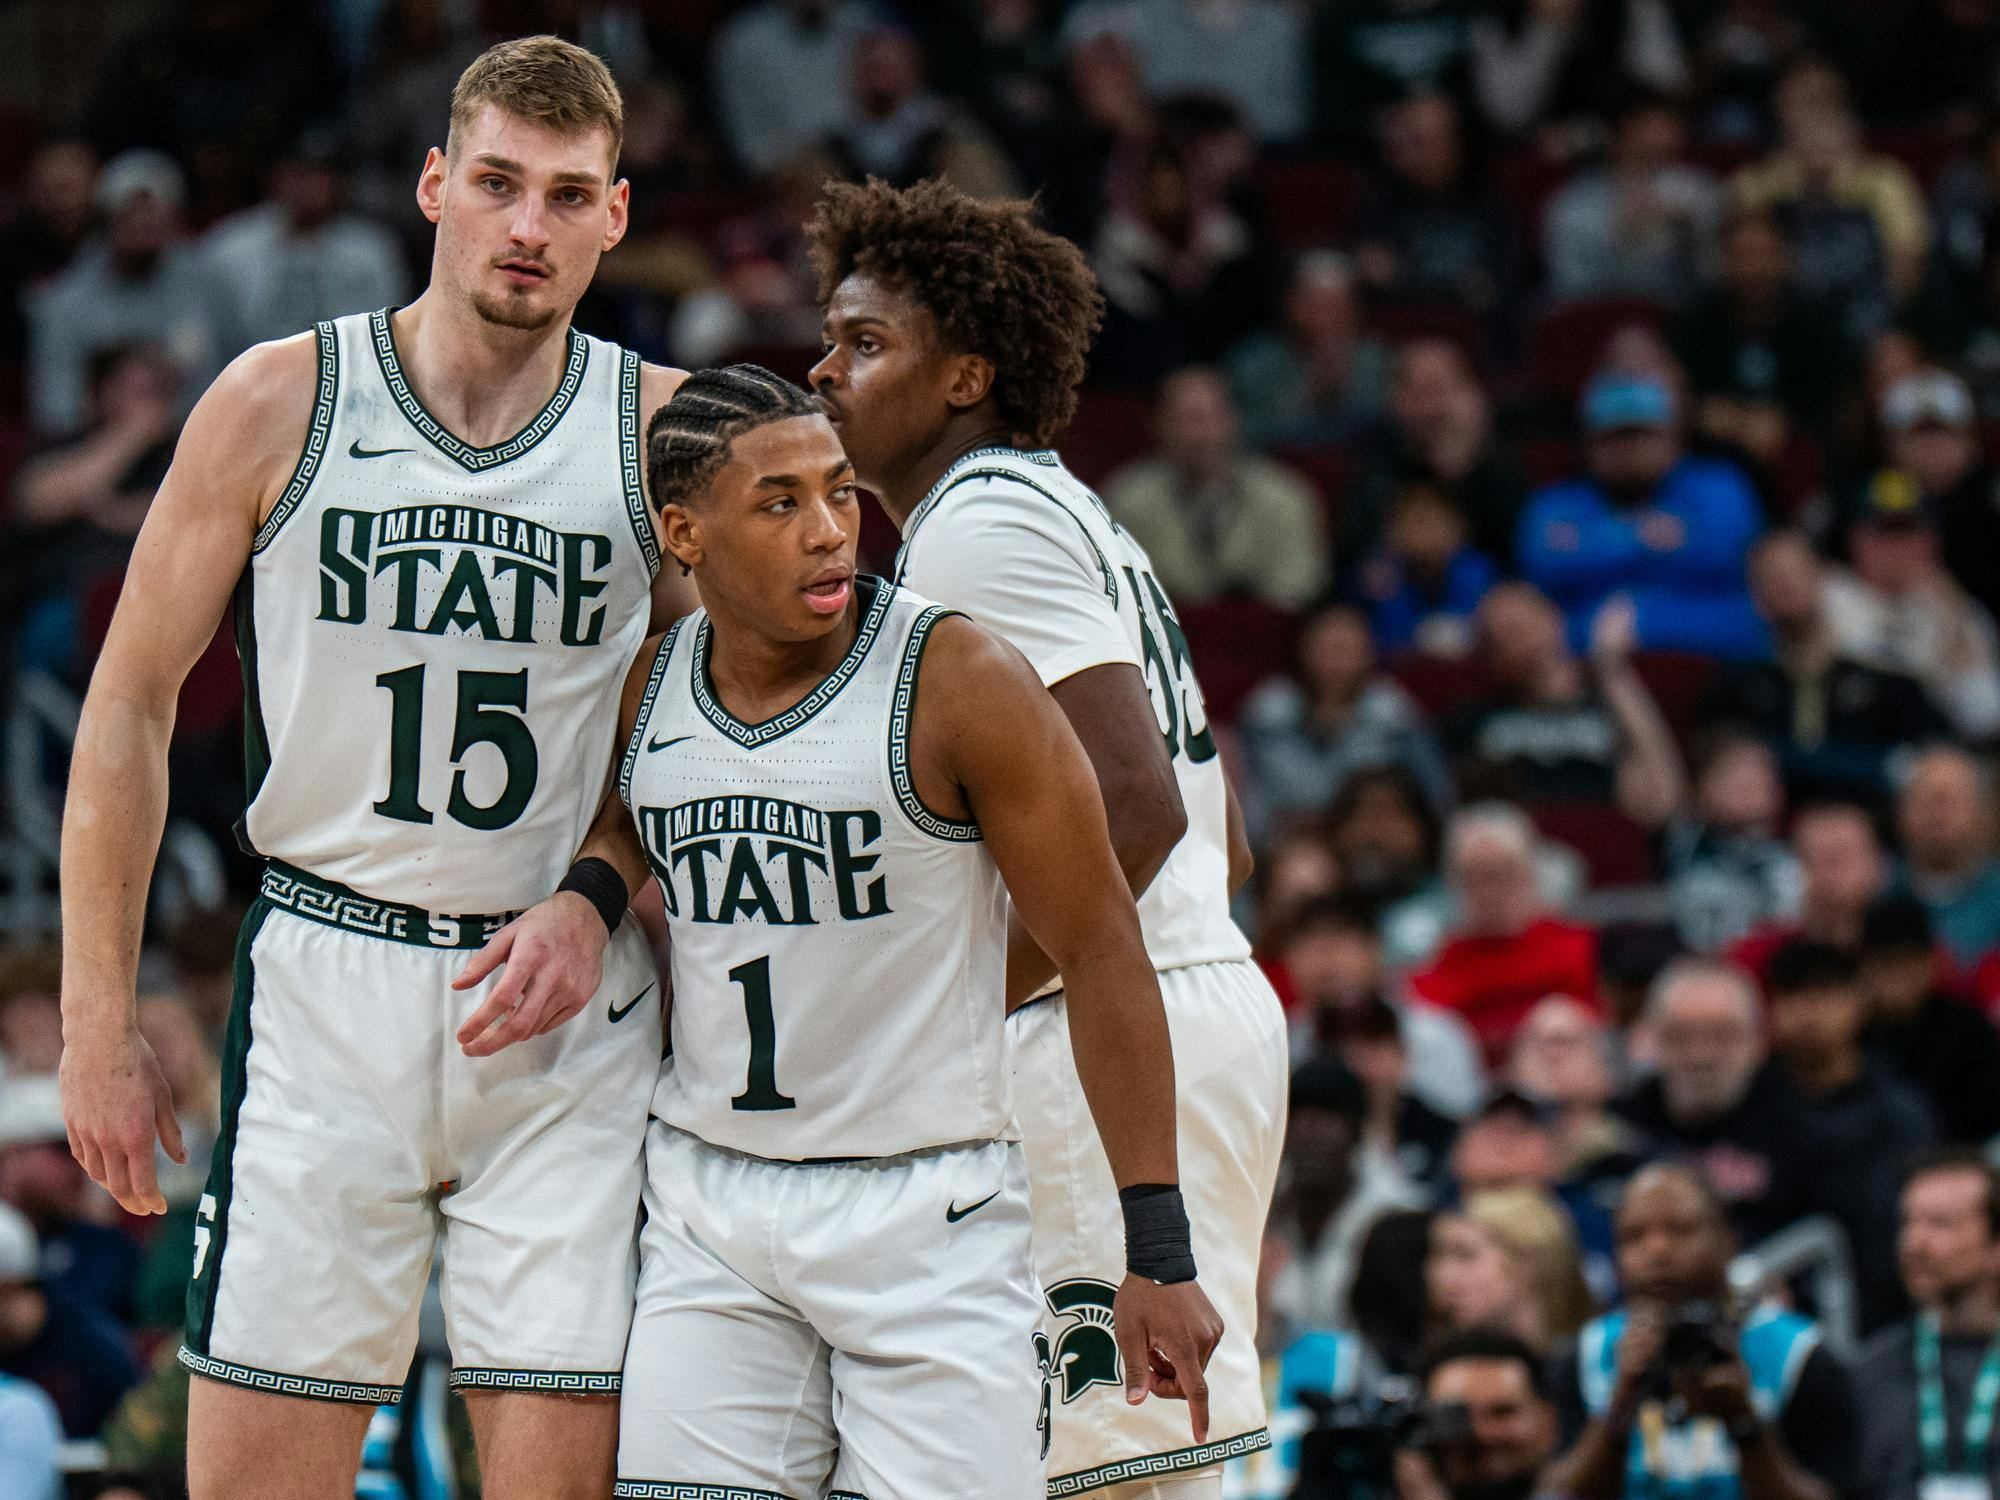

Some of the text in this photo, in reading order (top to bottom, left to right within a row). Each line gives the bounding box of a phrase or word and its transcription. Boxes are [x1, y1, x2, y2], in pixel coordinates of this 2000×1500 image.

[315, 507, 612, 646] STATE
[384, 508, 552, 562] MICHIGAN
[373, 663, 539, 831] 15
[638, 805, 894, 925] STATE
[674, 798, 819, 843] MICHIGAN
[728, 954, 796, 1111] 1
